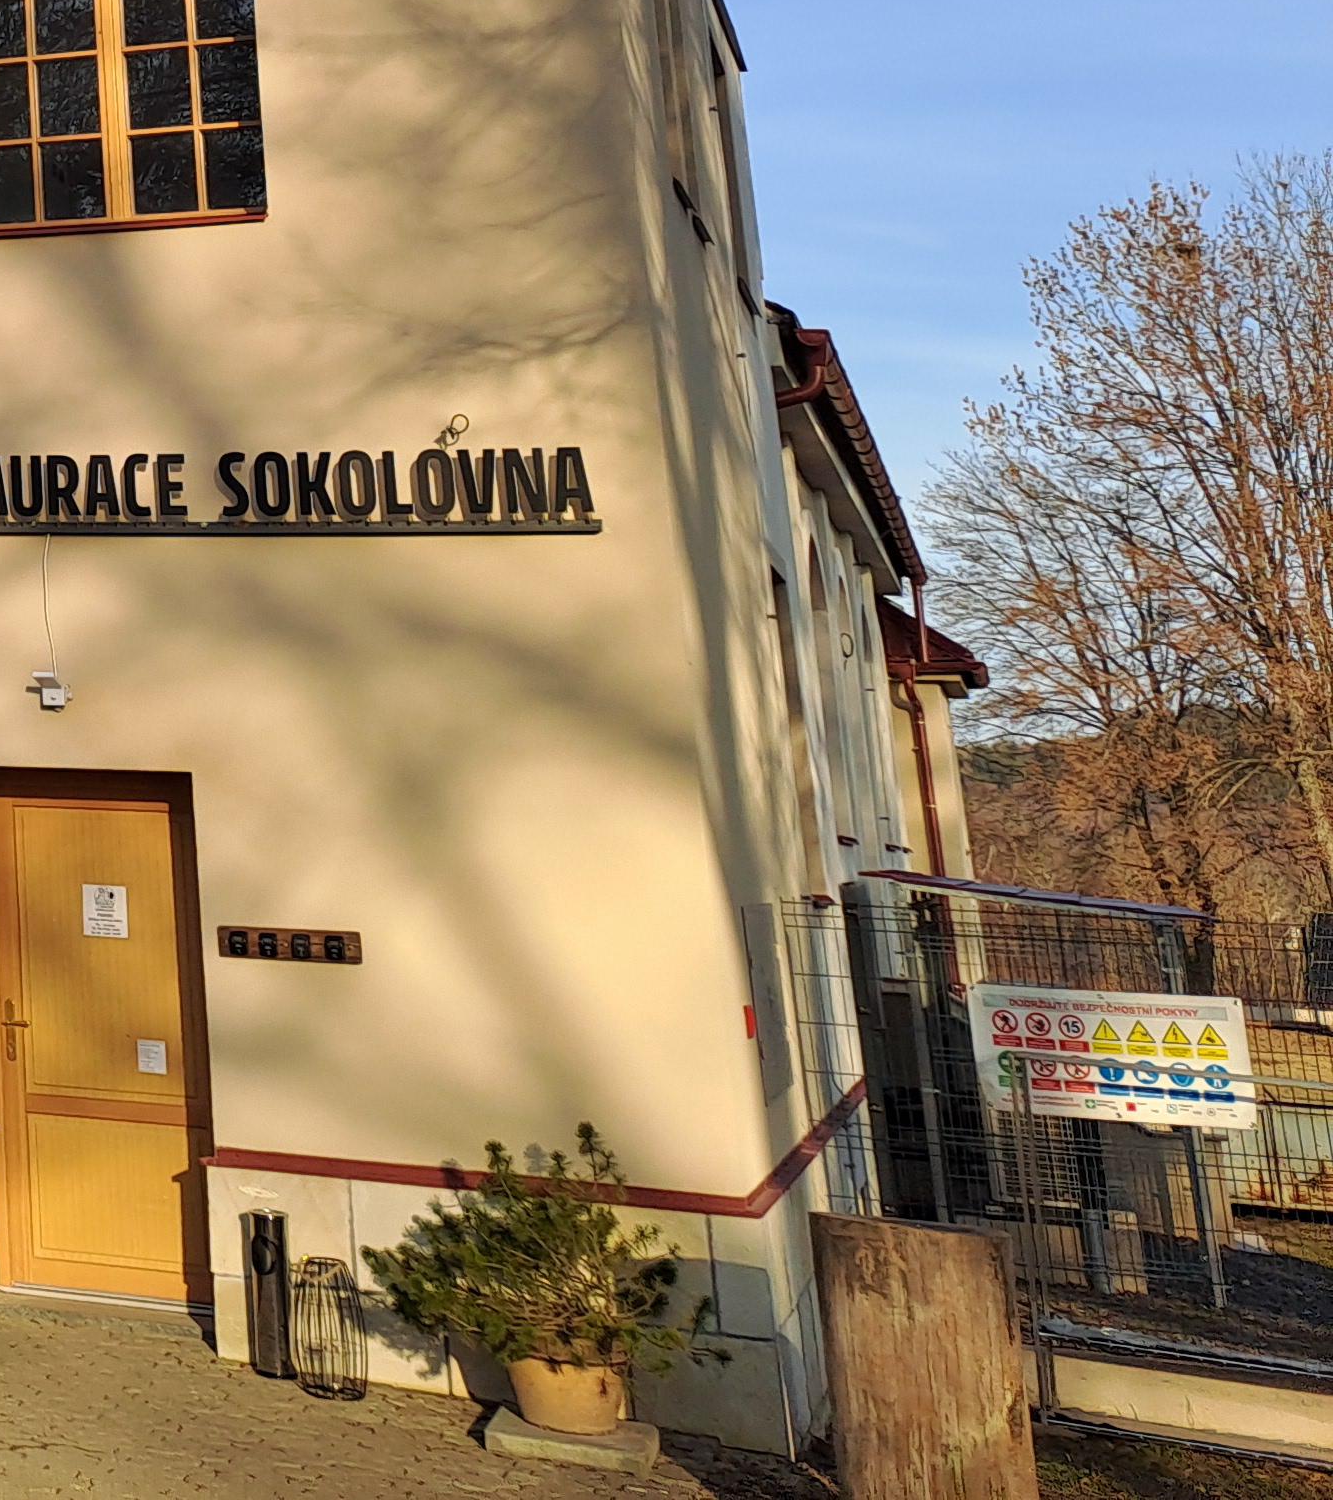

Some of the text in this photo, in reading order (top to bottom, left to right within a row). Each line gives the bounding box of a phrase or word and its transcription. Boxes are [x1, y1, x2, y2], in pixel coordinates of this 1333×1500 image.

[217, 446, 595, 518] SOKOLOVNA
[1155, 1007, 1199, 1018] POKYNY
[1062, 1020, 1081, 1034] 15
